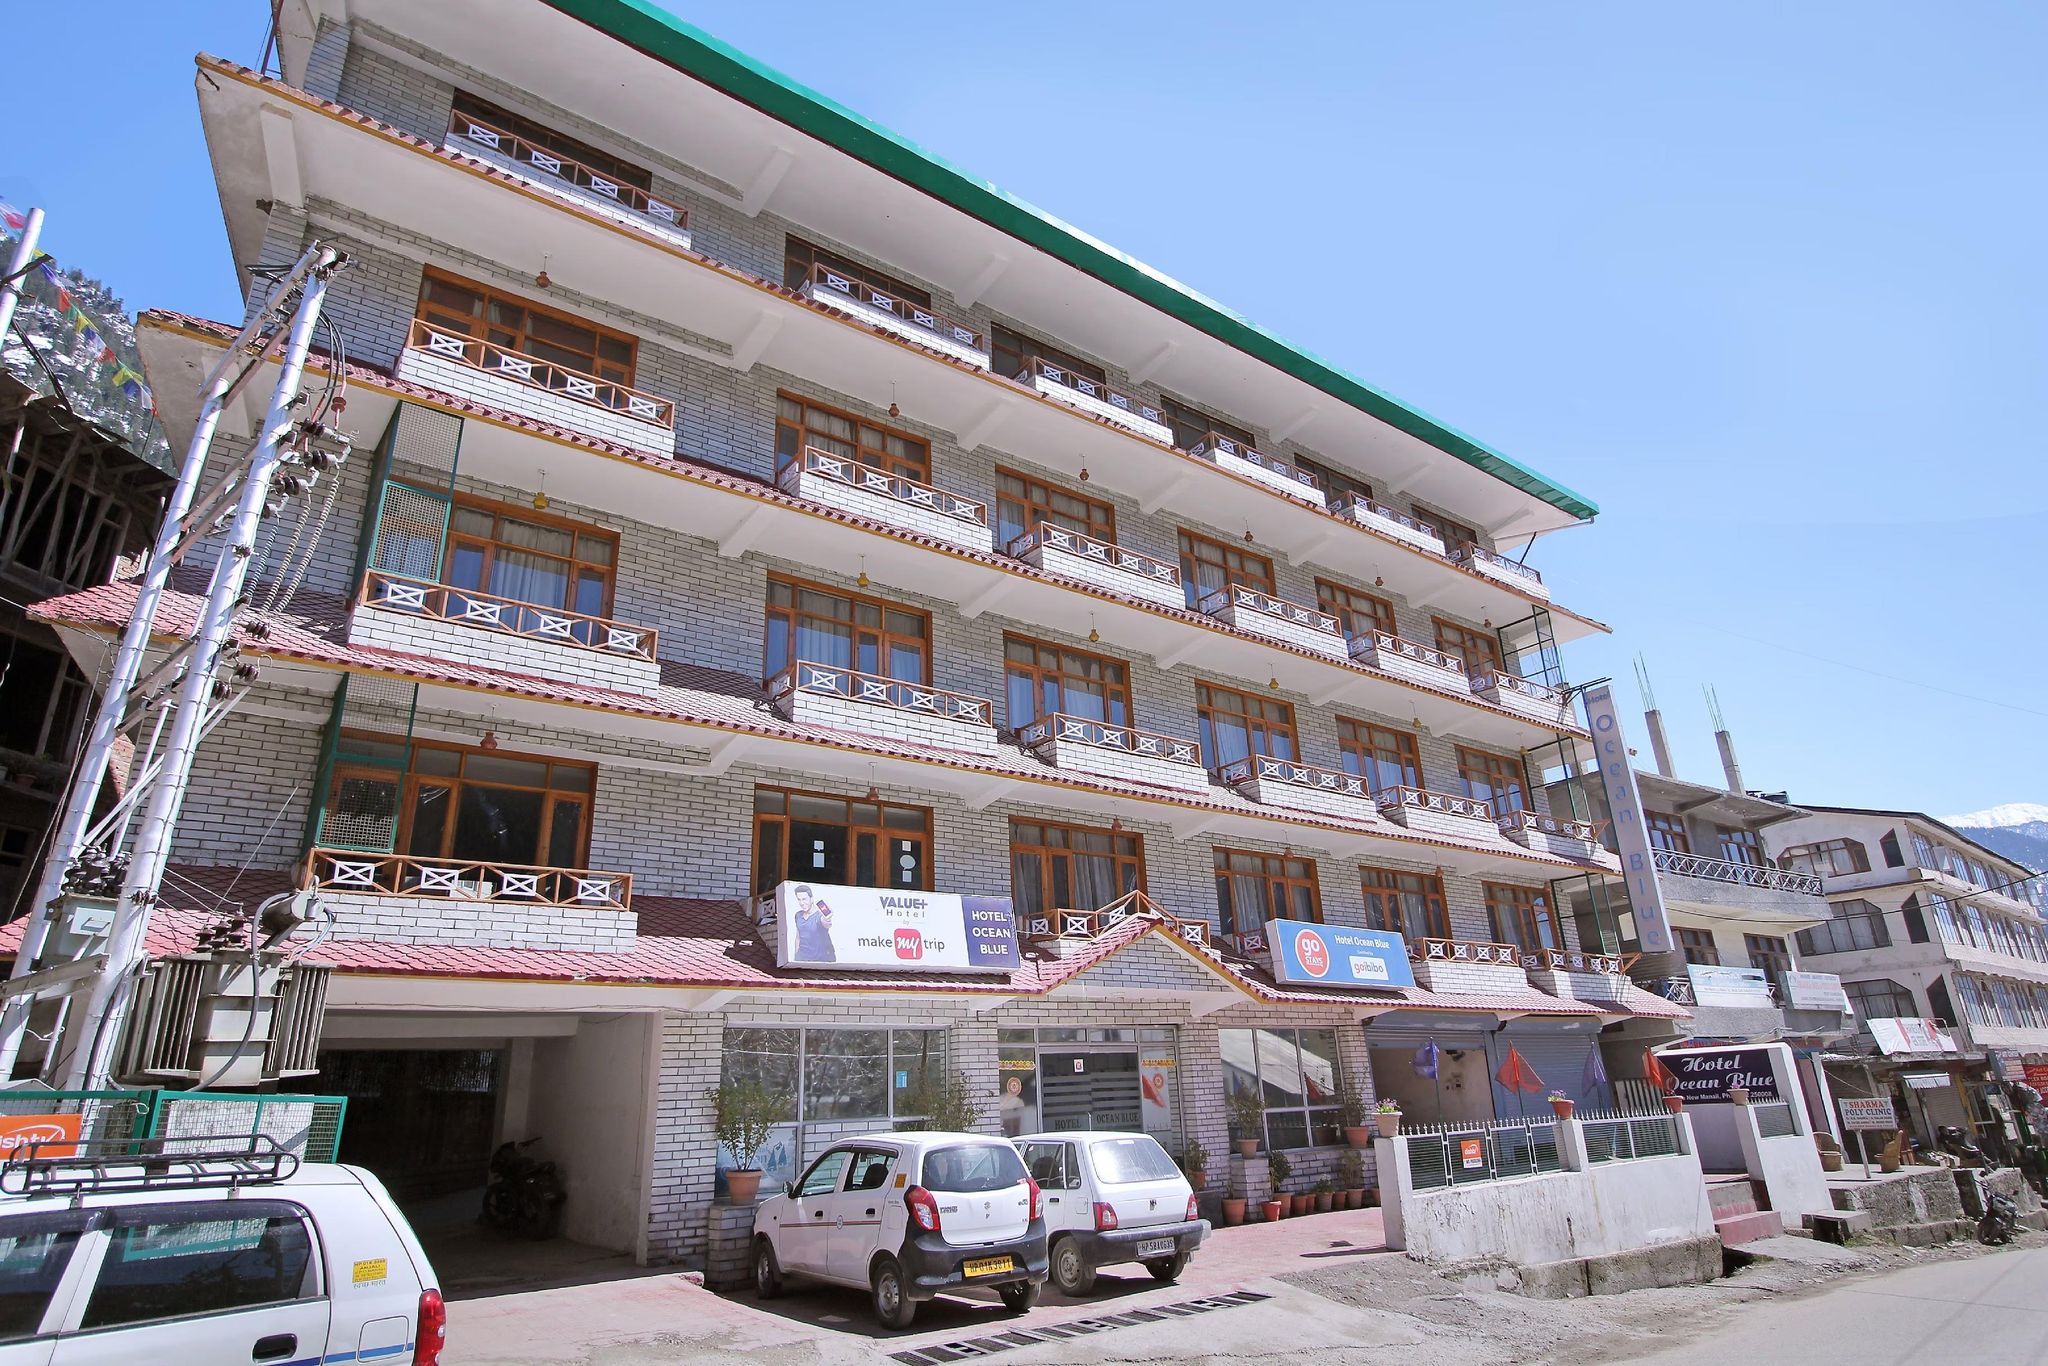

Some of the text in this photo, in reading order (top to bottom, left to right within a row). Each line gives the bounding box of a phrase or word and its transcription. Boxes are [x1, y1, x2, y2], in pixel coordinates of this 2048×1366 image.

[880, 896, 928, 909] VALUE+
[886, 909, 925, 918] Hotel
[971, 910, 1008, 922] HOTEL
[972, 927, 1011, 938] OCEAN
[1302, 938, 1320, 955] go
[1335, 935, 1390, 949] Hotel Ocean Blue
[980, 944, 1009, 955] BLUE
[1681, 1054, 1742, 1073] Hotel
[1725, 1072, 1775, 1089] Blue
[1866, 1108, 1892, 1116] CLINIC
